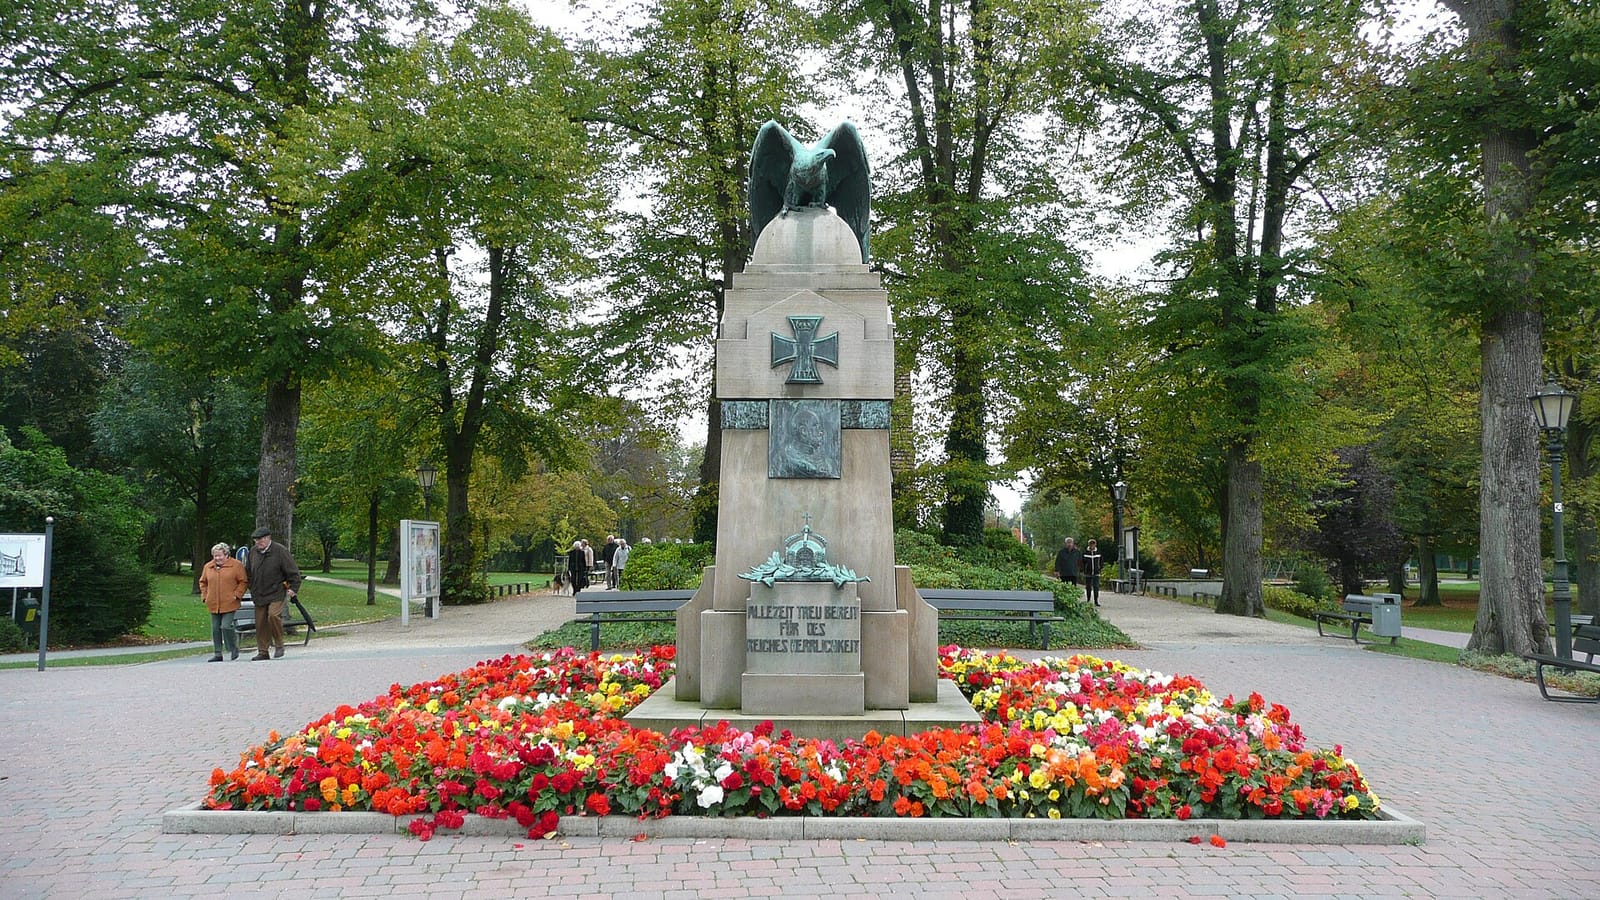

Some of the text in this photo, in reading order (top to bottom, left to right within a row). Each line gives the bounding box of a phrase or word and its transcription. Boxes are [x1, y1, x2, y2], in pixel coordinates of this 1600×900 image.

[748, 606, 859, 619] ALLEZEIT TREU BEREIT
[780, 620, 826, 636] FÜR DES
[747, 639, 788, 653] REICHES
